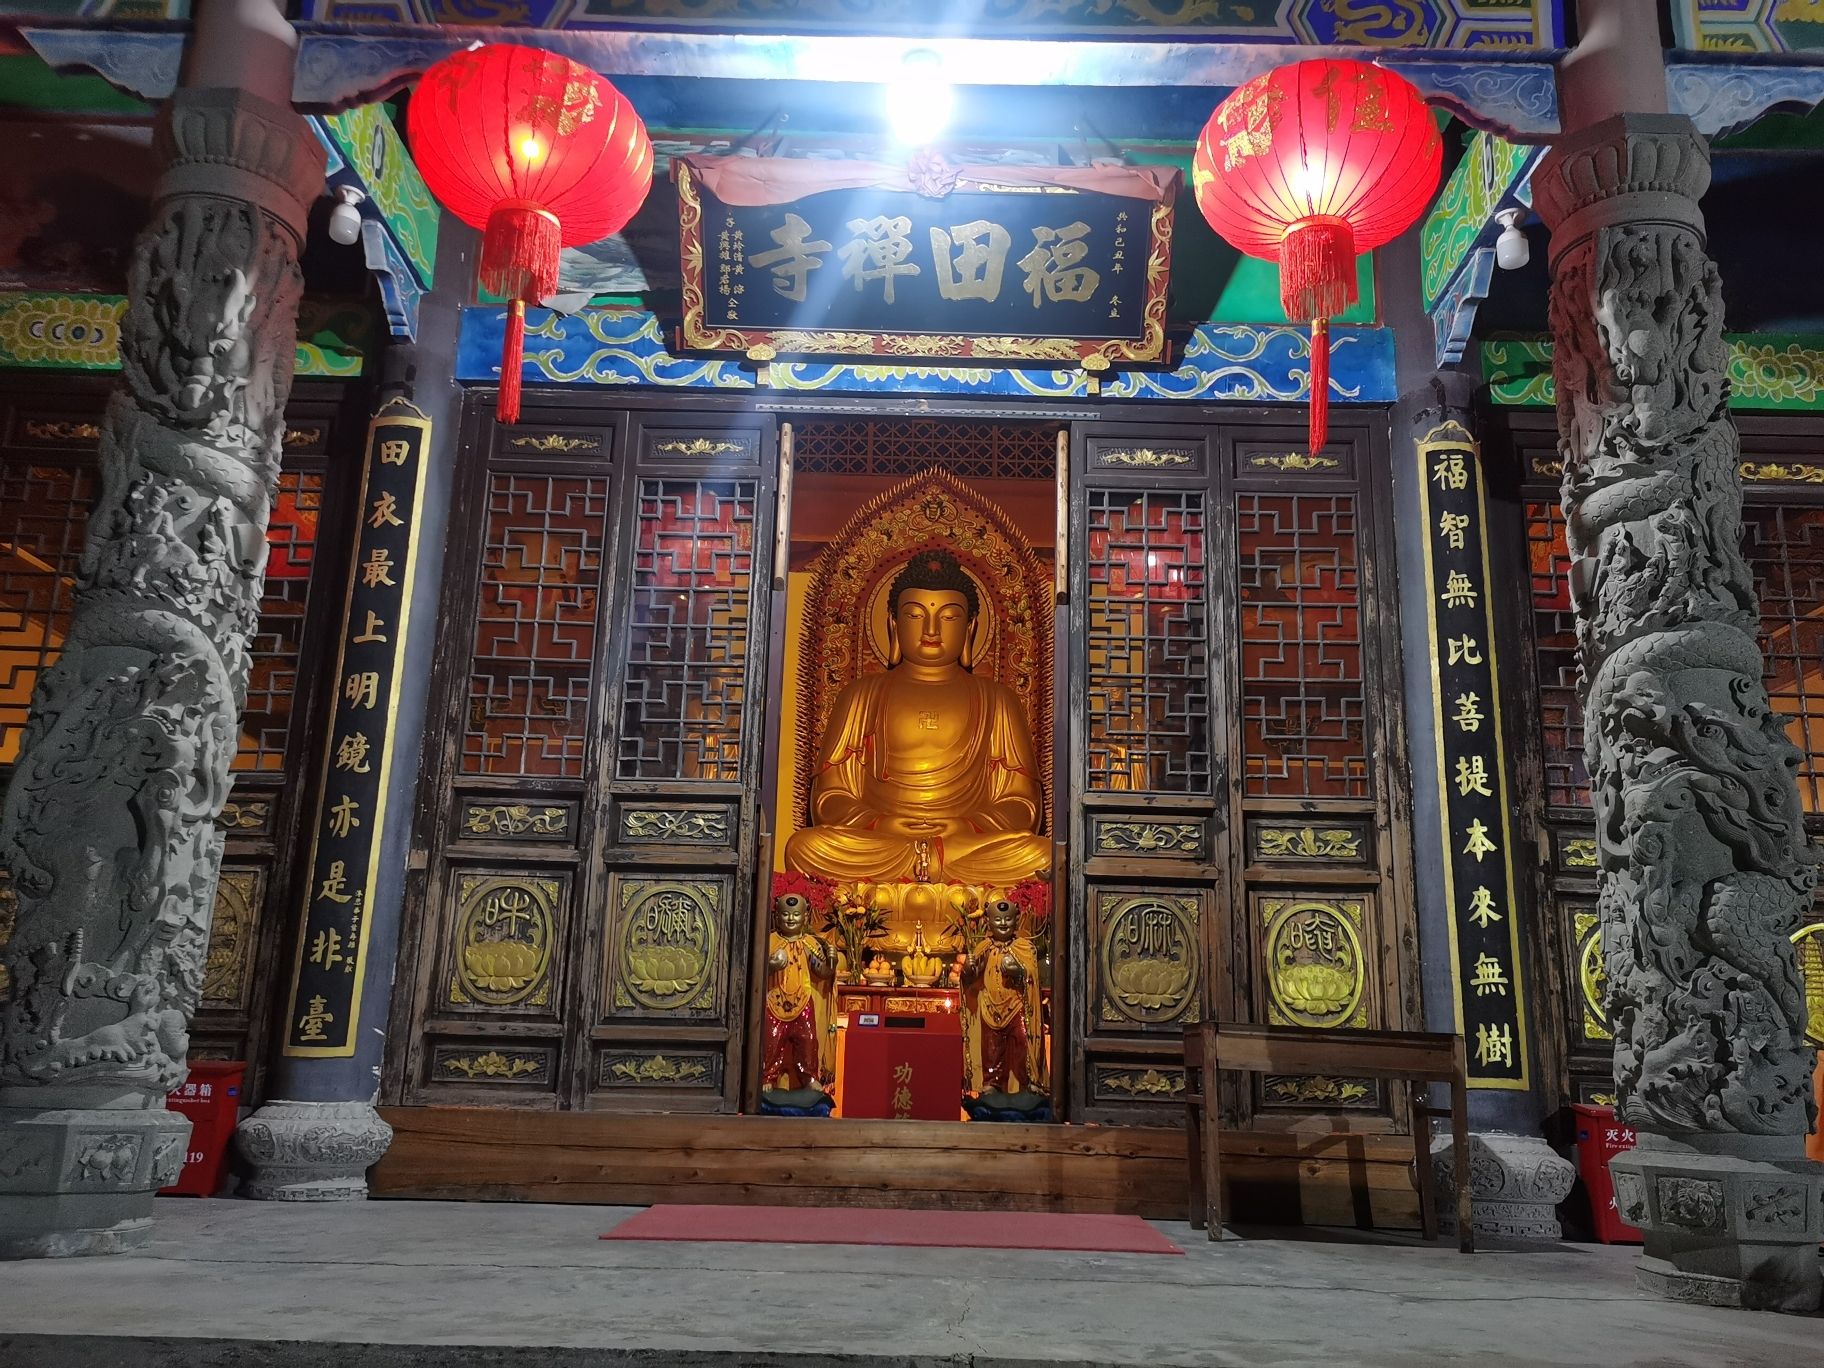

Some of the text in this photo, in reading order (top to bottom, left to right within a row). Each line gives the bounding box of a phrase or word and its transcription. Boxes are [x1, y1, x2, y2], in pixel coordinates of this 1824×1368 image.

[1432, 453, 1513, 1068] 福智無比菩提本來無樹
[1605, 1128, 1634, 1142] 灭火
